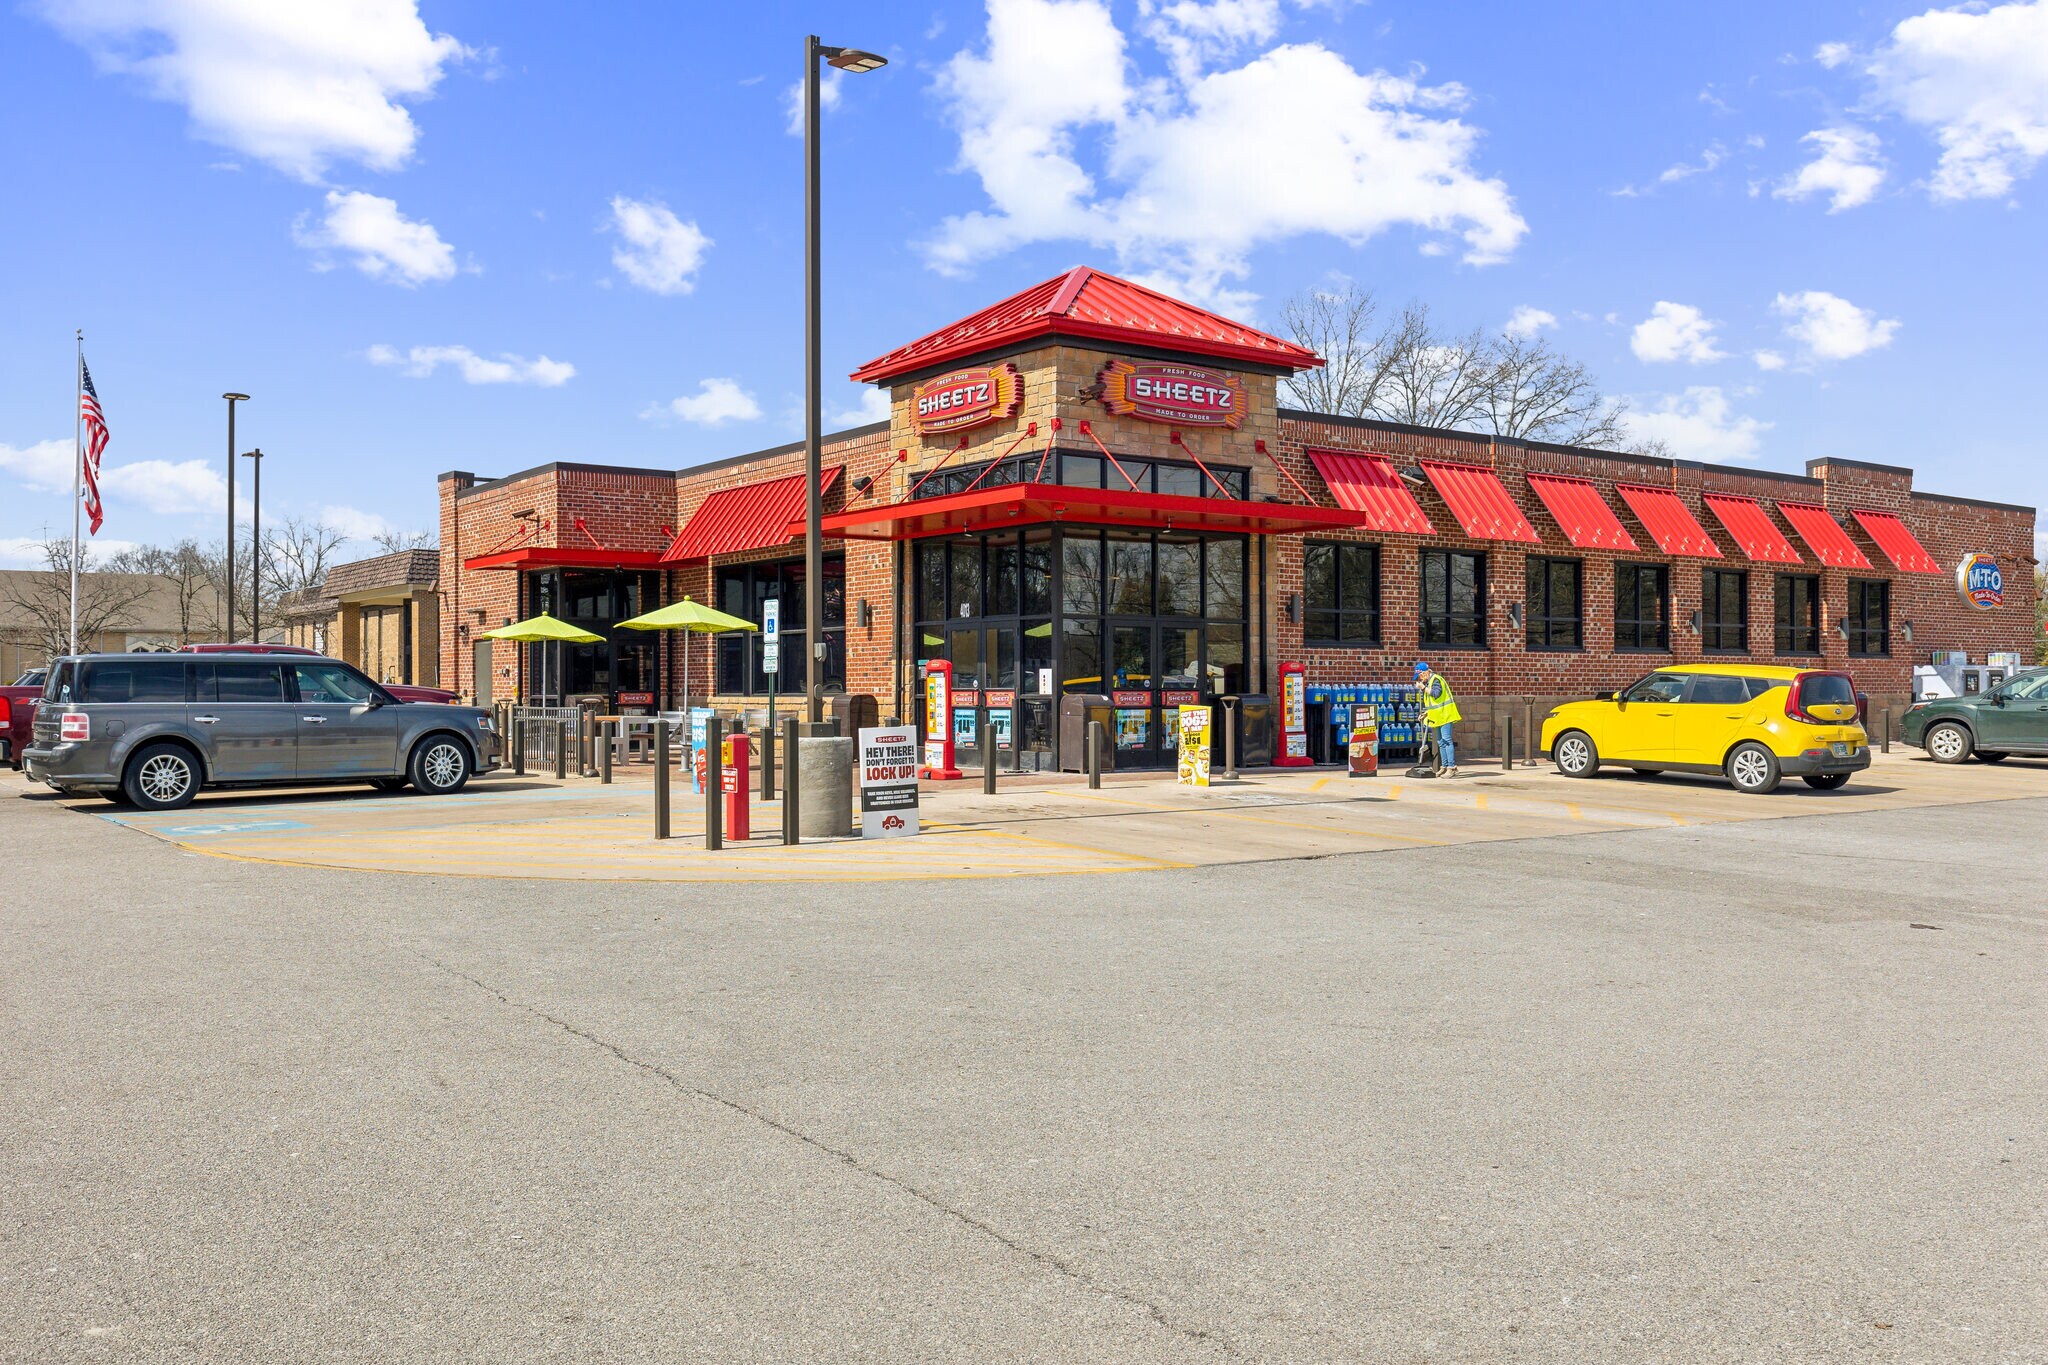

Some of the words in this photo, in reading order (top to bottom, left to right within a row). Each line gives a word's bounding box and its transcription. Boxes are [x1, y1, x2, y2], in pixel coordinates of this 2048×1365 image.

[1188, 369, 1206, 379] FOOD
[936, 377, 952, 386] FRESH
[1136, 378, 1231, 408] SHEETZ
[918, 383, 989, 416] SHEETZ
[1155, 408, 1174, 416] MADE
[956, 414, 974, 422] ORDER
[865, 746, 885, 758] HEY
[886, 745, 915, 757] THERE!
[866, 758, 885, 767] DON'T
[886, 757, 907, 766] FORGET
[907, 756, 915, 764] TO
[866, 766, 897, 781] LOCK
[898, 765, 915, 779] UP!
